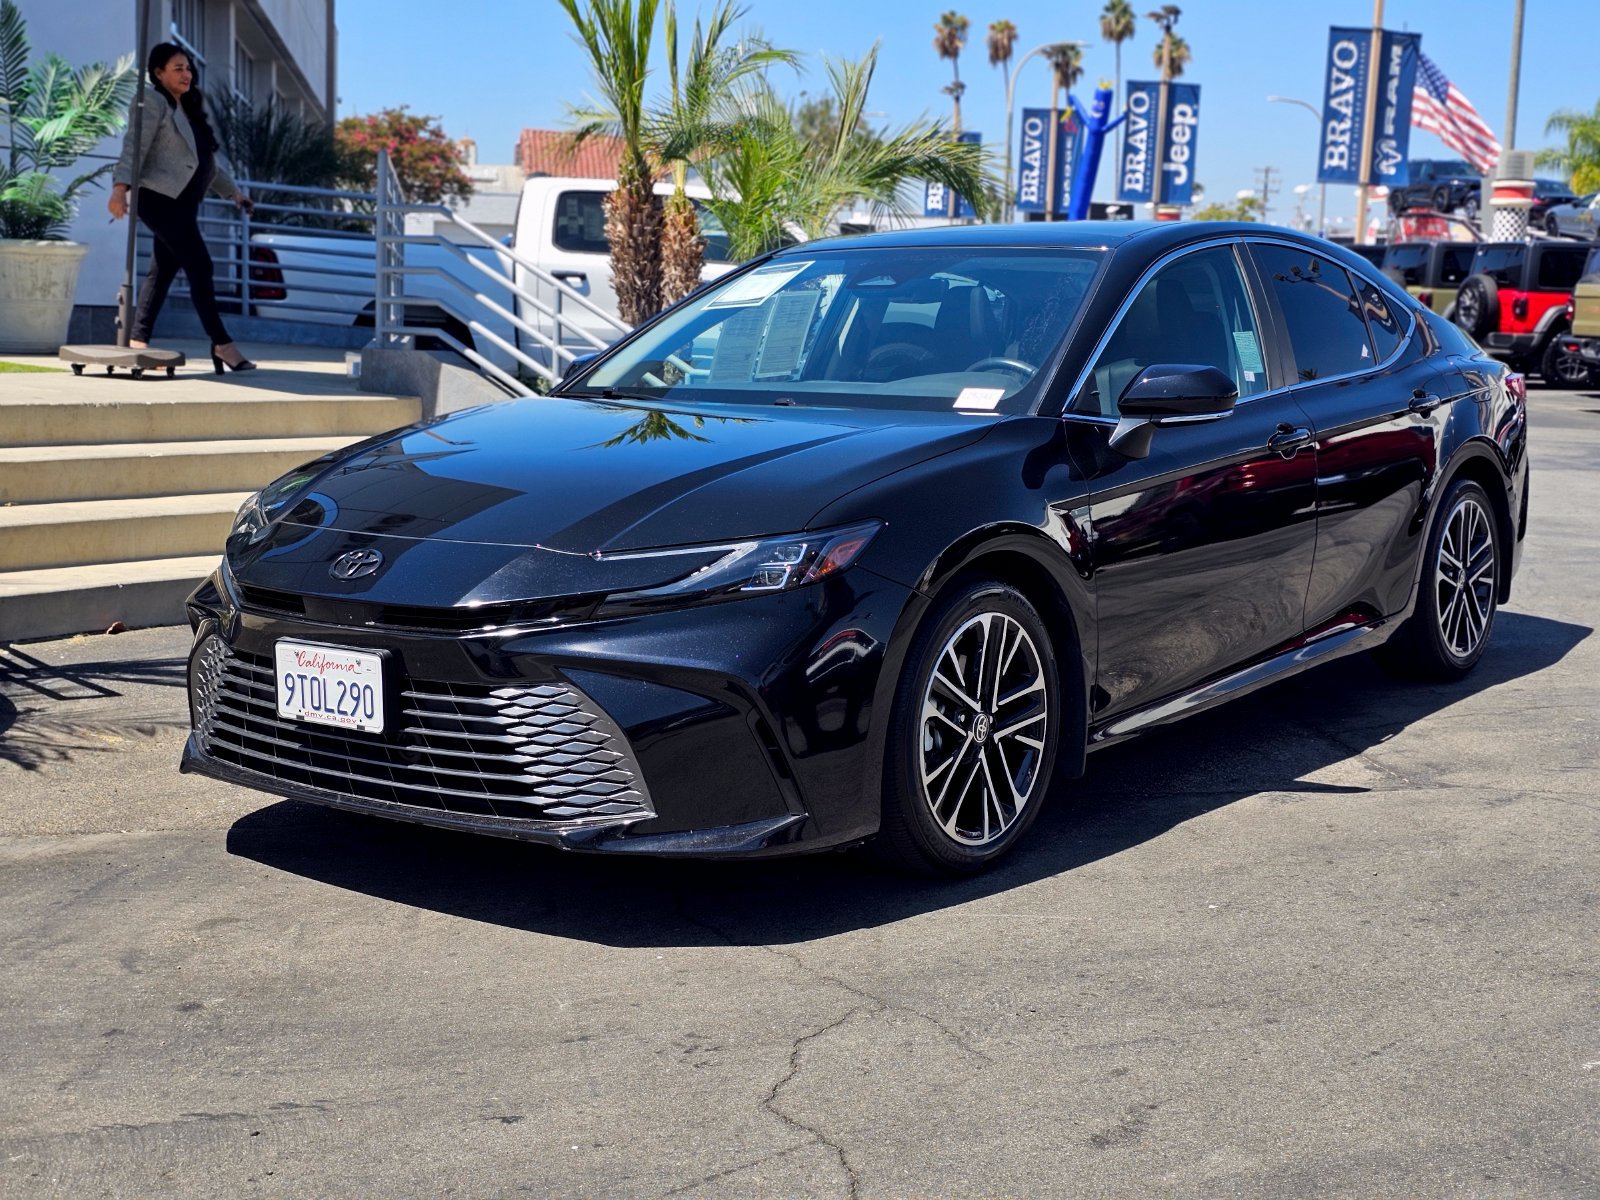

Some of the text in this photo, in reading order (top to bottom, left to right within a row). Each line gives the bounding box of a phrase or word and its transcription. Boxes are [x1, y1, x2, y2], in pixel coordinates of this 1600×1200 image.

[1324, 40, 1358, 170] BRAVO
[1384, 45, 1403, 135] RAM
[1021, 117, 1042, 204] BRAVO
[1124, 91, 1150, 192] BRAVO
[1162, 104, 1197, 186] Jeep
[297, 650, 362, 675] California
[304, 711, 357, 724] dmv.ca.gov
